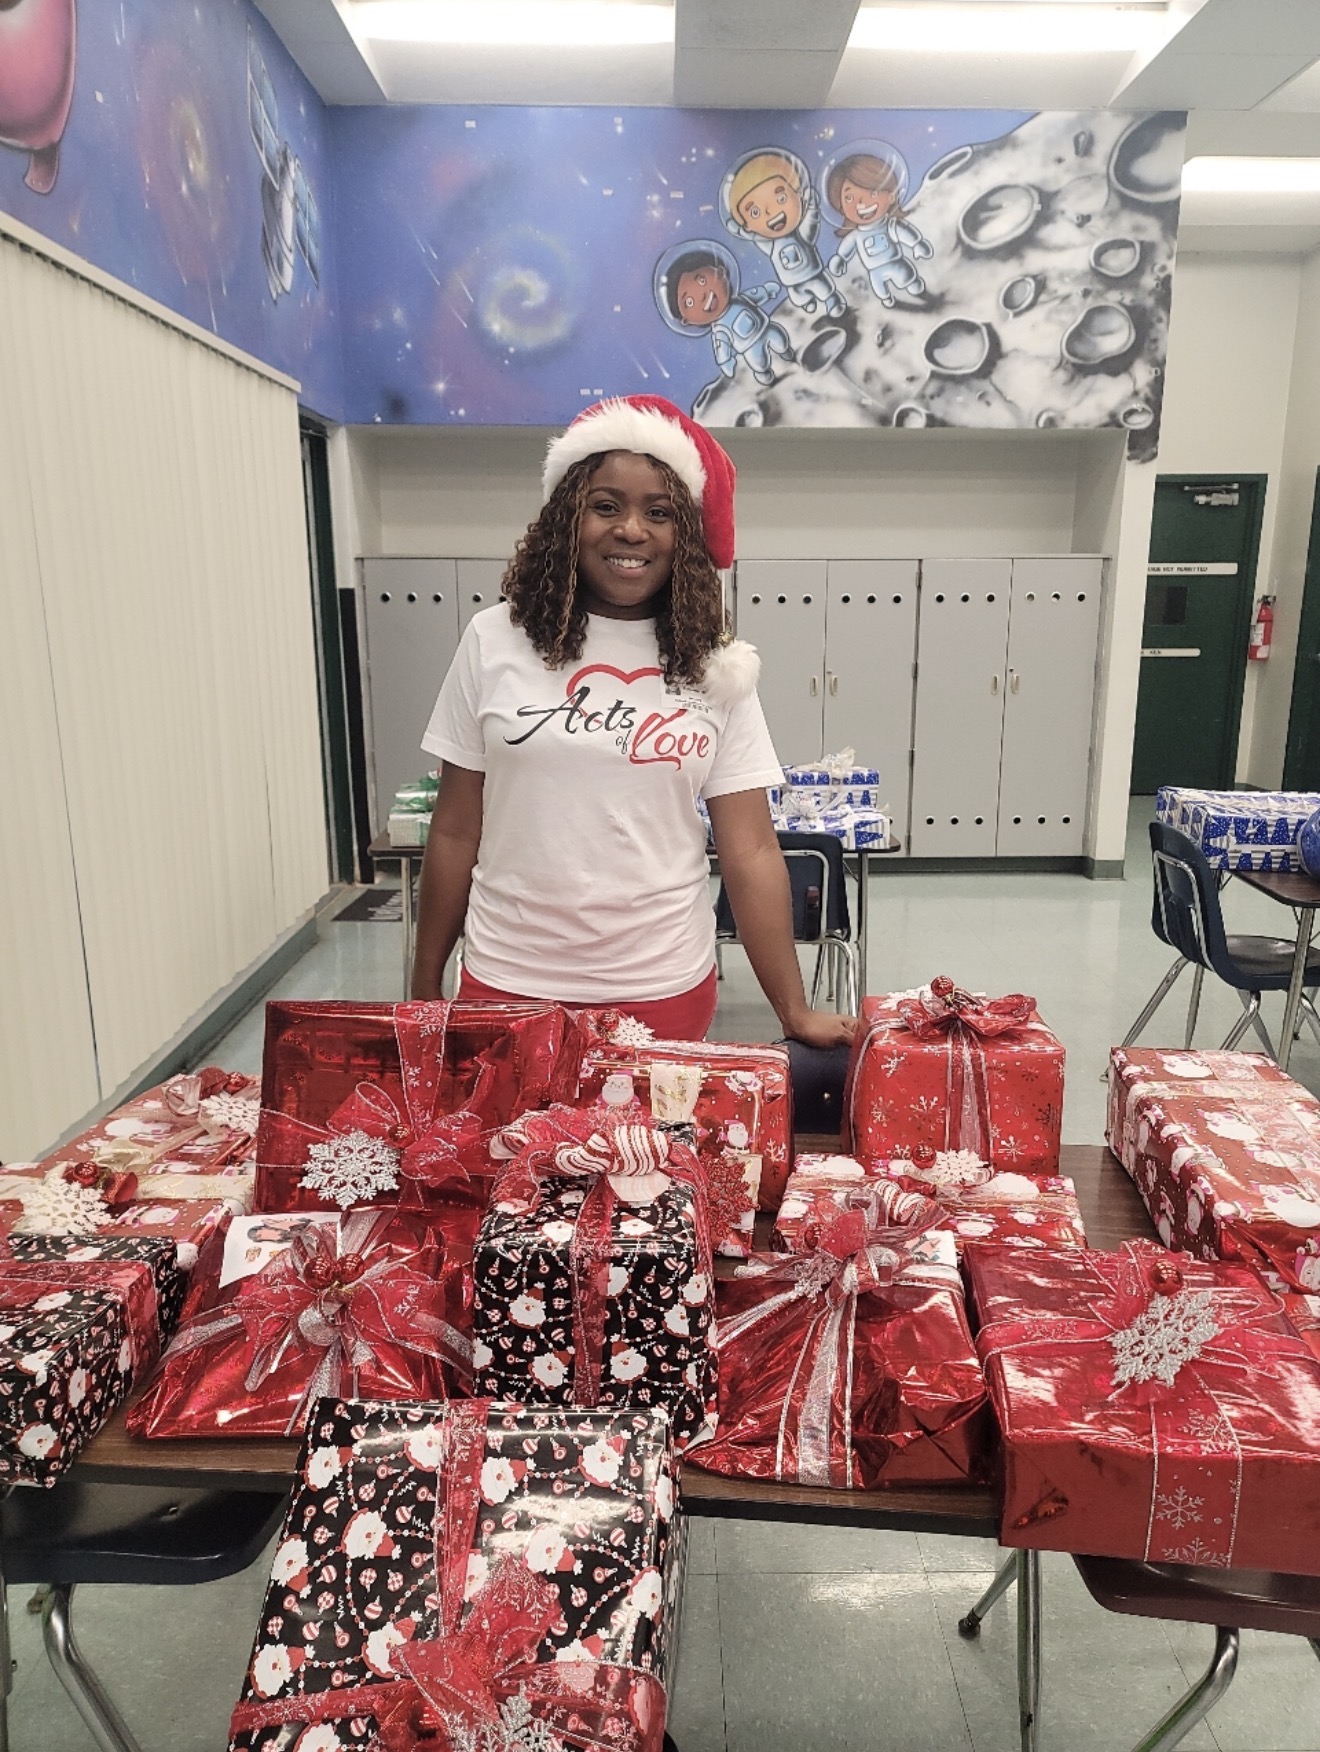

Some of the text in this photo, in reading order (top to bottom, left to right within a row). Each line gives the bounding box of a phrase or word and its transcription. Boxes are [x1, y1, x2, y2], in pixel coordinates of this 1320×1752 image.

[502, 685, 637, 746] Acts
[615, 709, 710, 772] of Love
